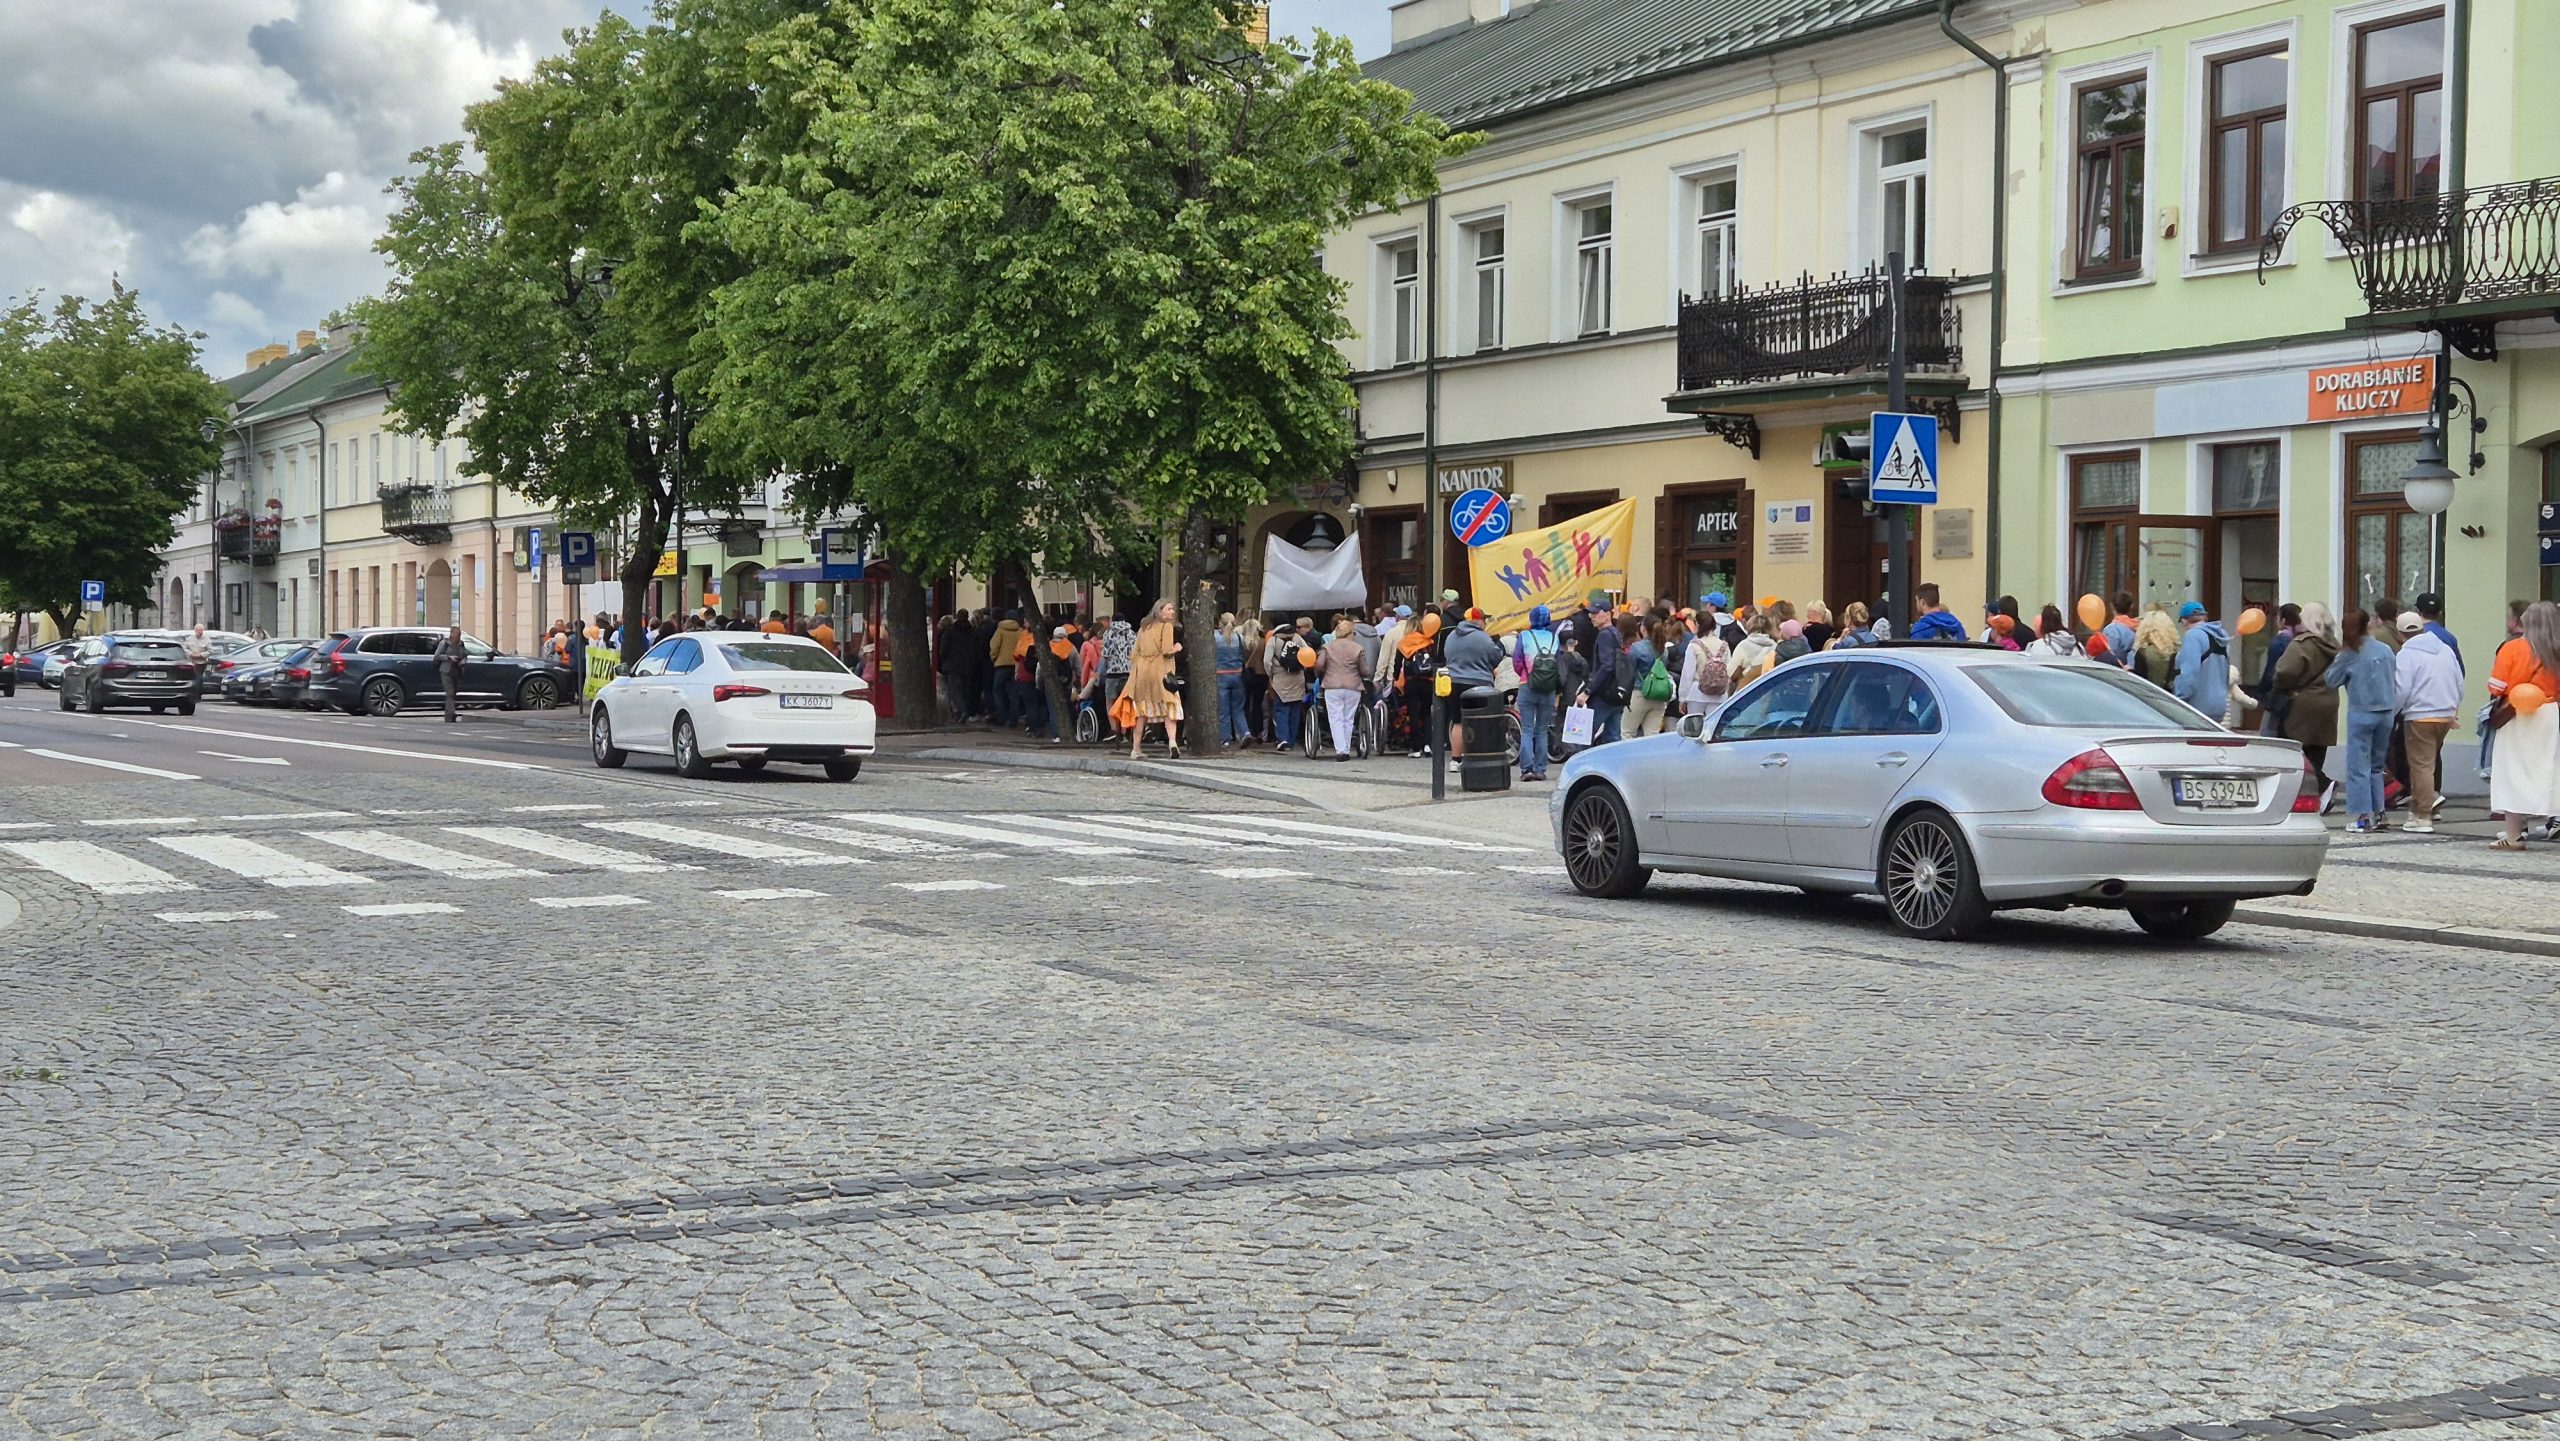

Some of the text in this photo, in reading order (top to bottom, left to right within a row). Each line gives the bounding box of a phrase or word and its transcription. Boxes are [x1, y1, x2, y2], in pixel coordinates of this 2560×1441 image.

[2315, 365, 2424, 392] DORABIANIE
[2336, 389, 2401, 412] KLUCZY
[1439, 466, 1504, 493] KANTOR
[569, 536, 588, 563] P
[86, 583, 99, 599] P
[786, 696, 829, 706] KK 3607Y
[2185, 782, 2254, 800] BS 6394A
